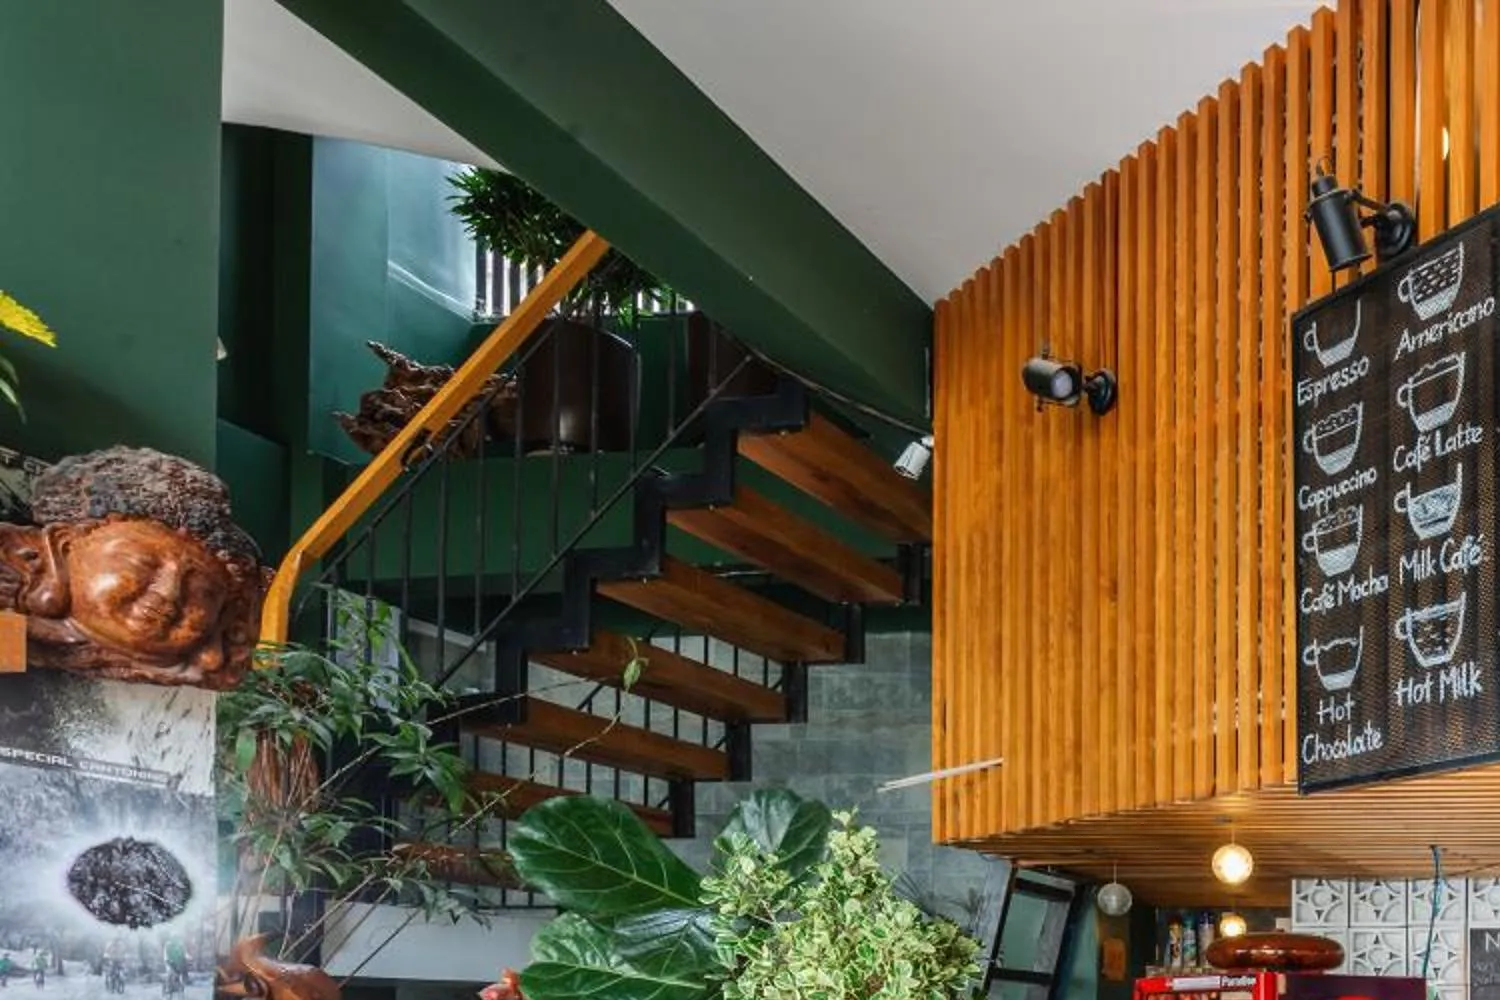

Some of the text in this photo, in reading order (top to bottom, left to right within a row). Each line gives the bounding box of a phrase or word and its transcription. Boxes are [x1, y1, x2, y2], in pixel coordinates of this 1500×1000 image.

[1393, 295, 1496, 362] Americano
[1296, 355, 1370, 408] Espresso
[1434, 422, 1485, 457] Latte
[1399, 533, 1485, 585] Milk Café
[1336, 572, 1391, 605] Mocha
[1393, 660, 1484, 706] Hot Milk
[1316, 699, 1356, 726] Hot
[1300, 724, 1384, 766] Chocolate
